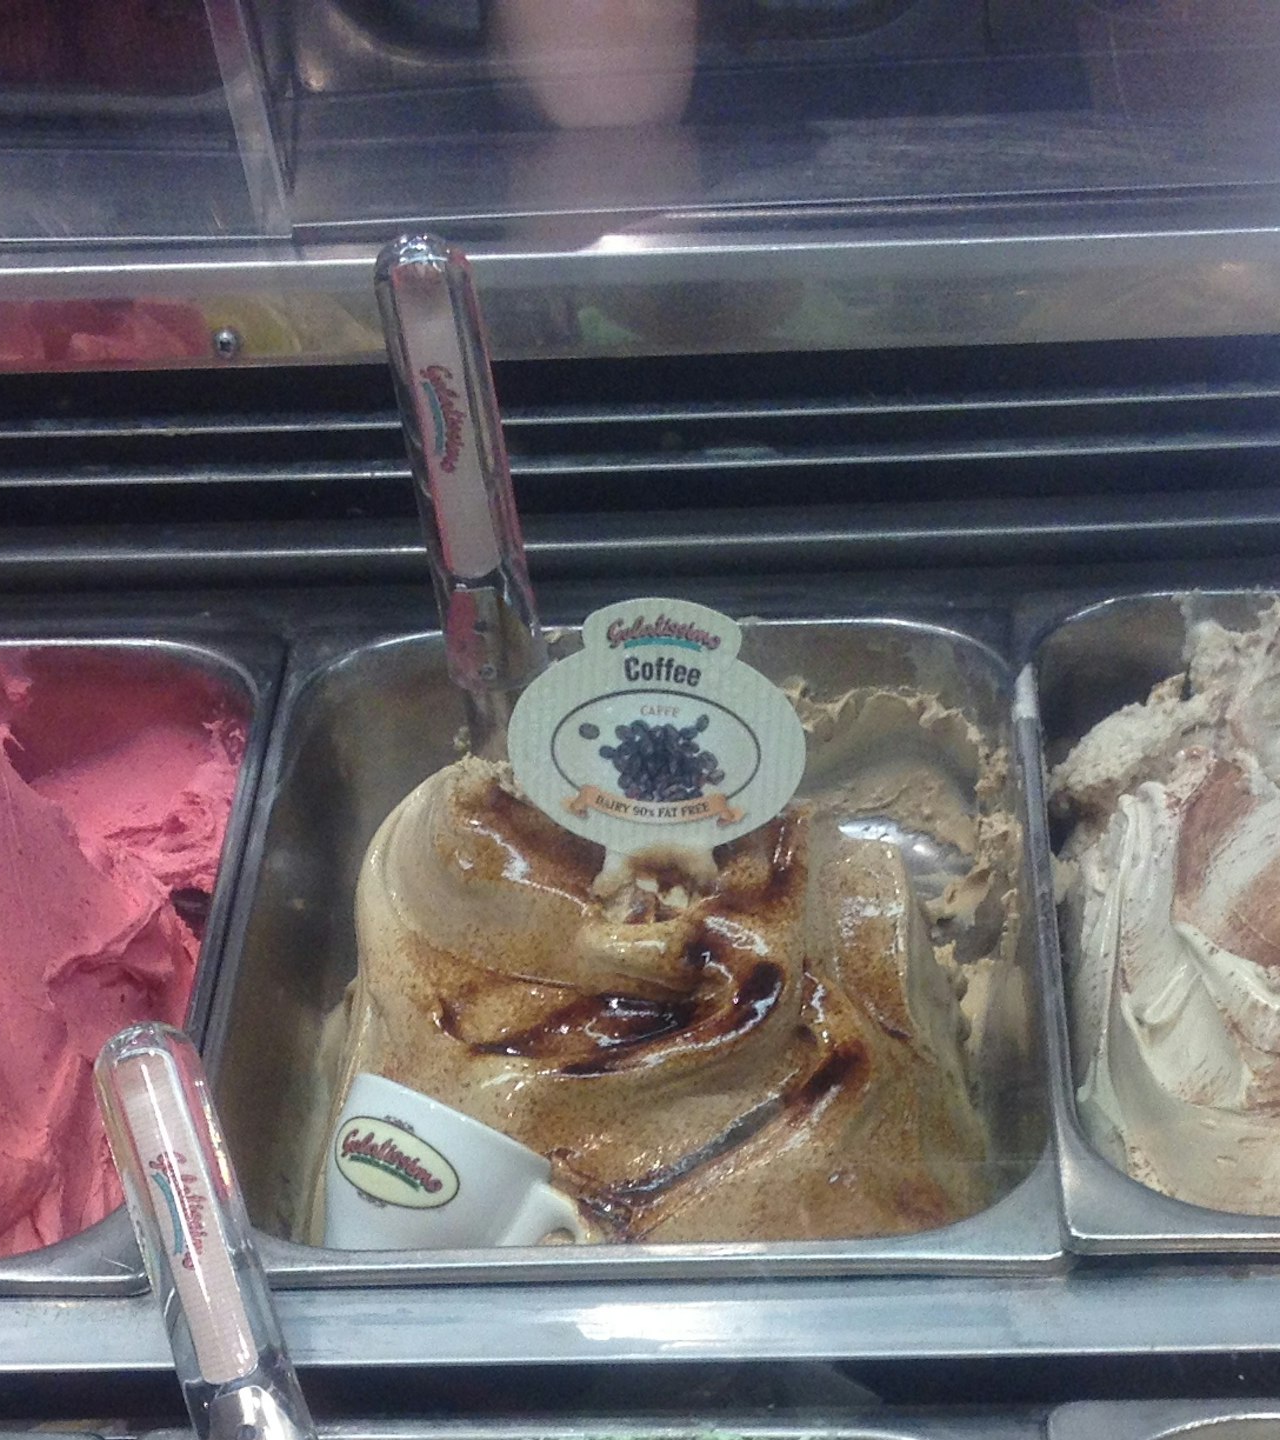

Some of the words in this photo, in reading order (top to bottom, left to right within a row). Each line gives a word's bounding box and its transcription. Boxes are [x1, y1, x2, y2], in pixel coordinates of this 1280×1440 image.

[624, 656, 702, 687] Coffee
[595, 794, 632, 814] DAIRY
[633, 806, 655, 817] 90%
[658, 806, 677, 818] FAT
[681, 802, 710, 816] FREE
